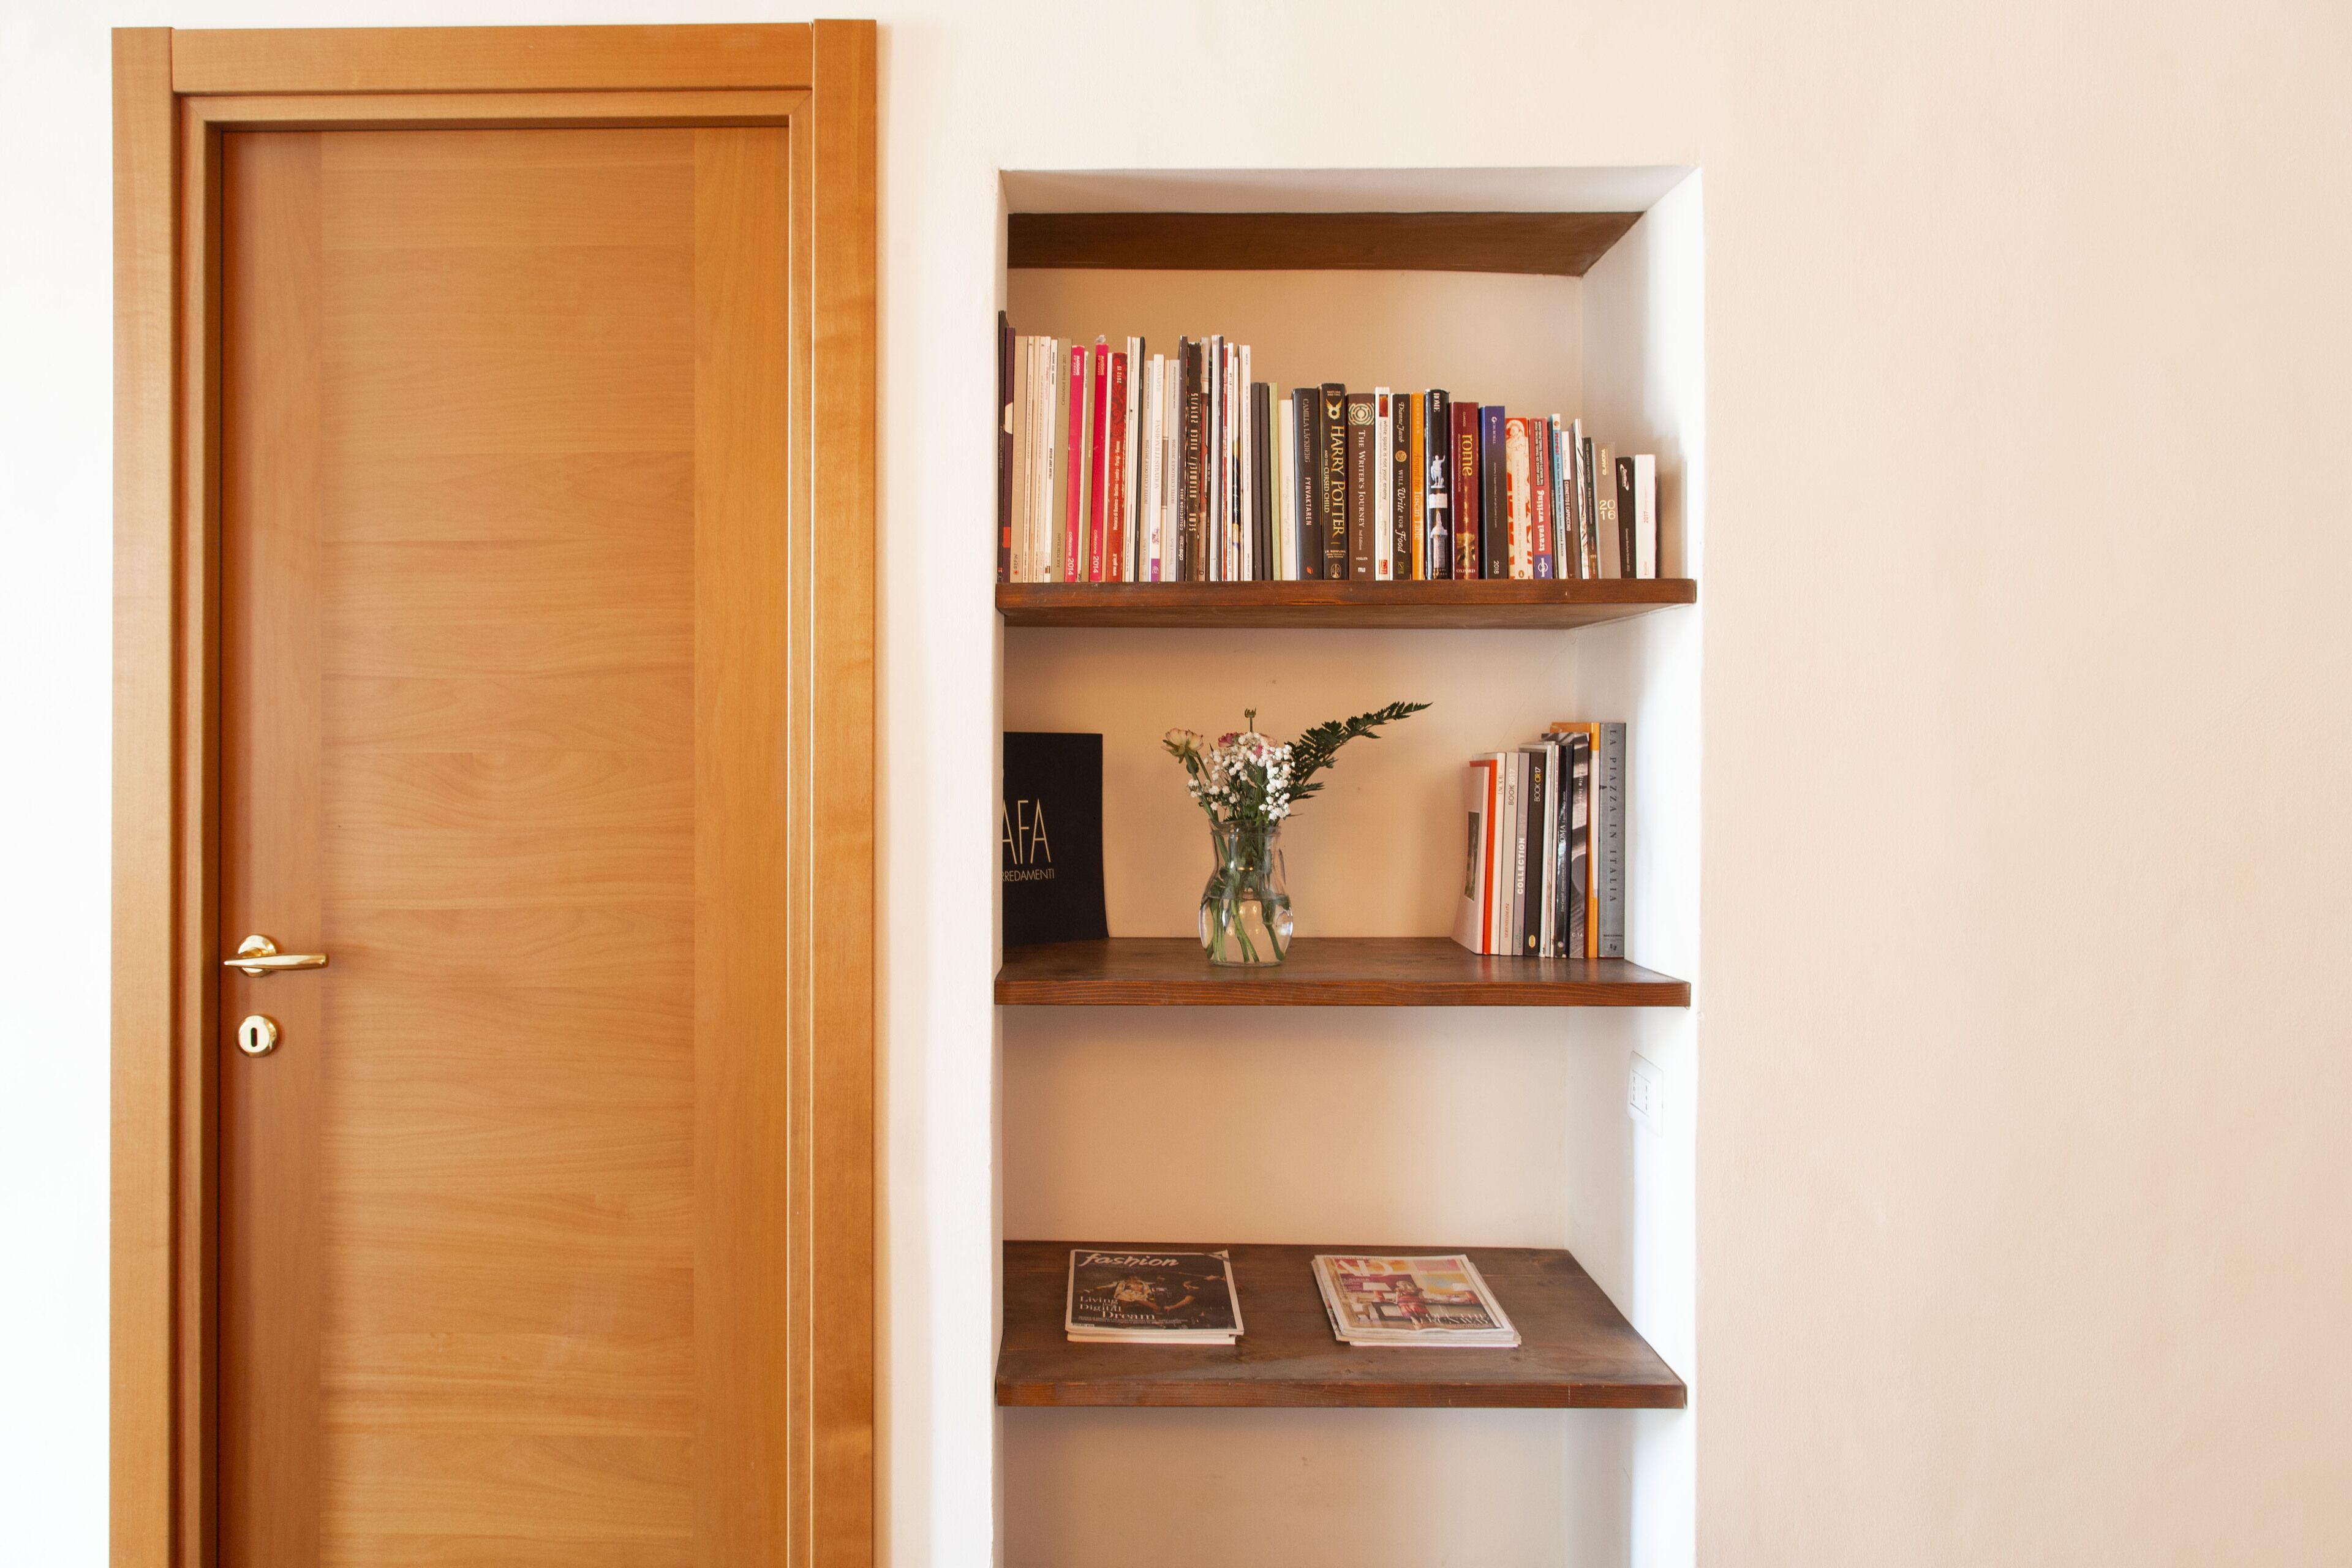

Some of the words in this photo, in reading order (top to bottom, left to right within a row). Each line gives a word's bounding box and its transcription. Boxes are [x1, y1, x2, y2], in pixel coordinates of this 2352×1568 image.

[1394, 424, 1405, 443] Jacob
[1330, 424, 1346, 477] HARRY
[1462, 434, 1473, 477] rome
[1330, 480, 1346, 538] POTTER
[1357, 491, 1366, 527] JOURNEY
[1397, 487, 1407, 513] Write
[1414, 491, 1422, 517] Tuscan
[1599, 499, 1616, 510] 20
[1600, 510, 1616, 521] 16
[1414, 520, 1422, 540] Table
[1395, 529, 1407, 554] Food
[1609, 729, 1617, 745] LA
[1609, 823, 1617, 839] IN
[1517, 837, 1526, 895] COLLECTION
[1078, 1253, 1179, 1267] fashion
[1338, 1259, 1393, 1277] AD
[1080, 1296, 1118, 1305] Living
[1080, 1303, 1121, 1312] Digital
[1102, 1311, 1155, 1320] Dream
